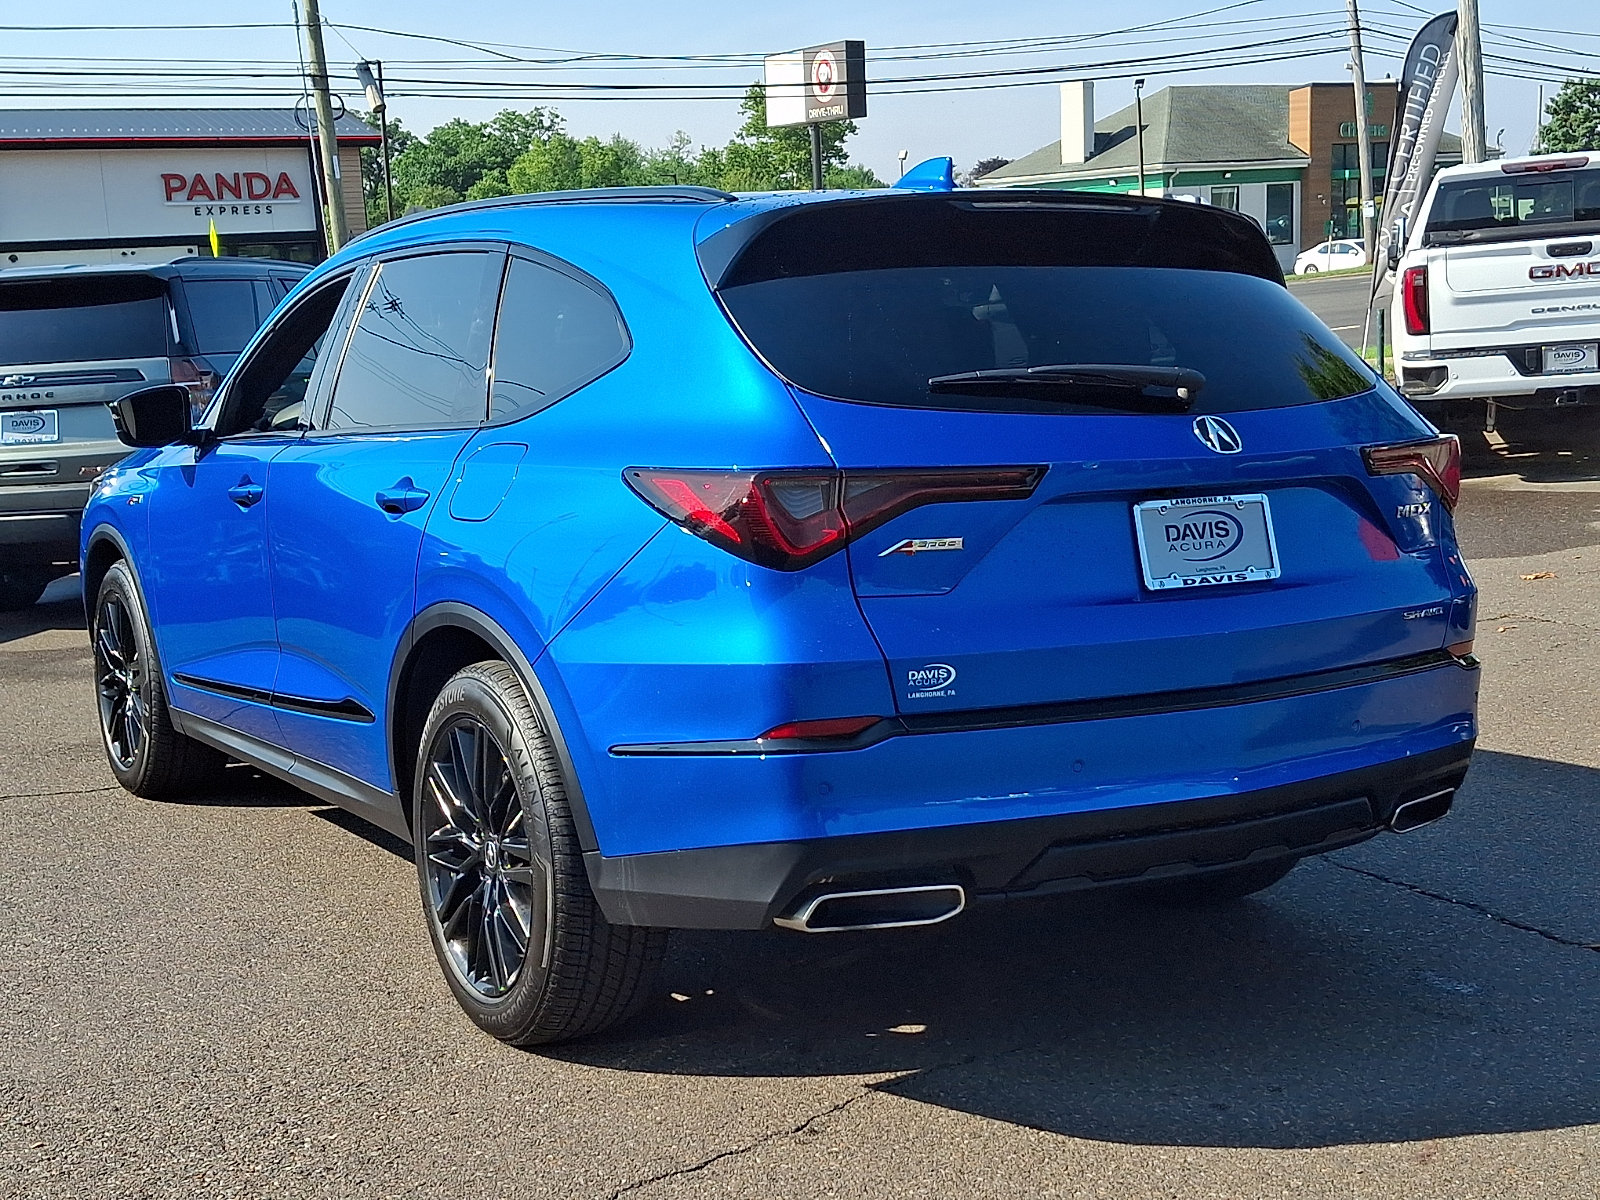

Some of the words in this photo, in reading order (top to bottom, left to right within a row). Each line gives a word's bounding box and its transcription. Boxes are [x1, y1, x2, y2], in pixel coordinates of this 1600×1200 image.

[808, 104, 844, 119] DRIVE-THRU
[1391, 43, 1441, 183] CERTIFIED
[1406, 109, 1434, 182] PRE-OWNED
[160, 172, 300, 202] PANDA
[194, 205, 273, 216] EXPRESS
[1553, 351, 1581, 359] DAVIS
[11, 419, 40, 428] DAVIS
[1397, 502, 1431, 518] MDX
[1164, 520, 1230, 542] DAVIS
[1168, 540, 1226, 553] ACURA
[1182, 573, 1248, 586] DAVIS
[908, 669, 948, 680] DAVIS
[908, 678, 944, 686] ACURA
